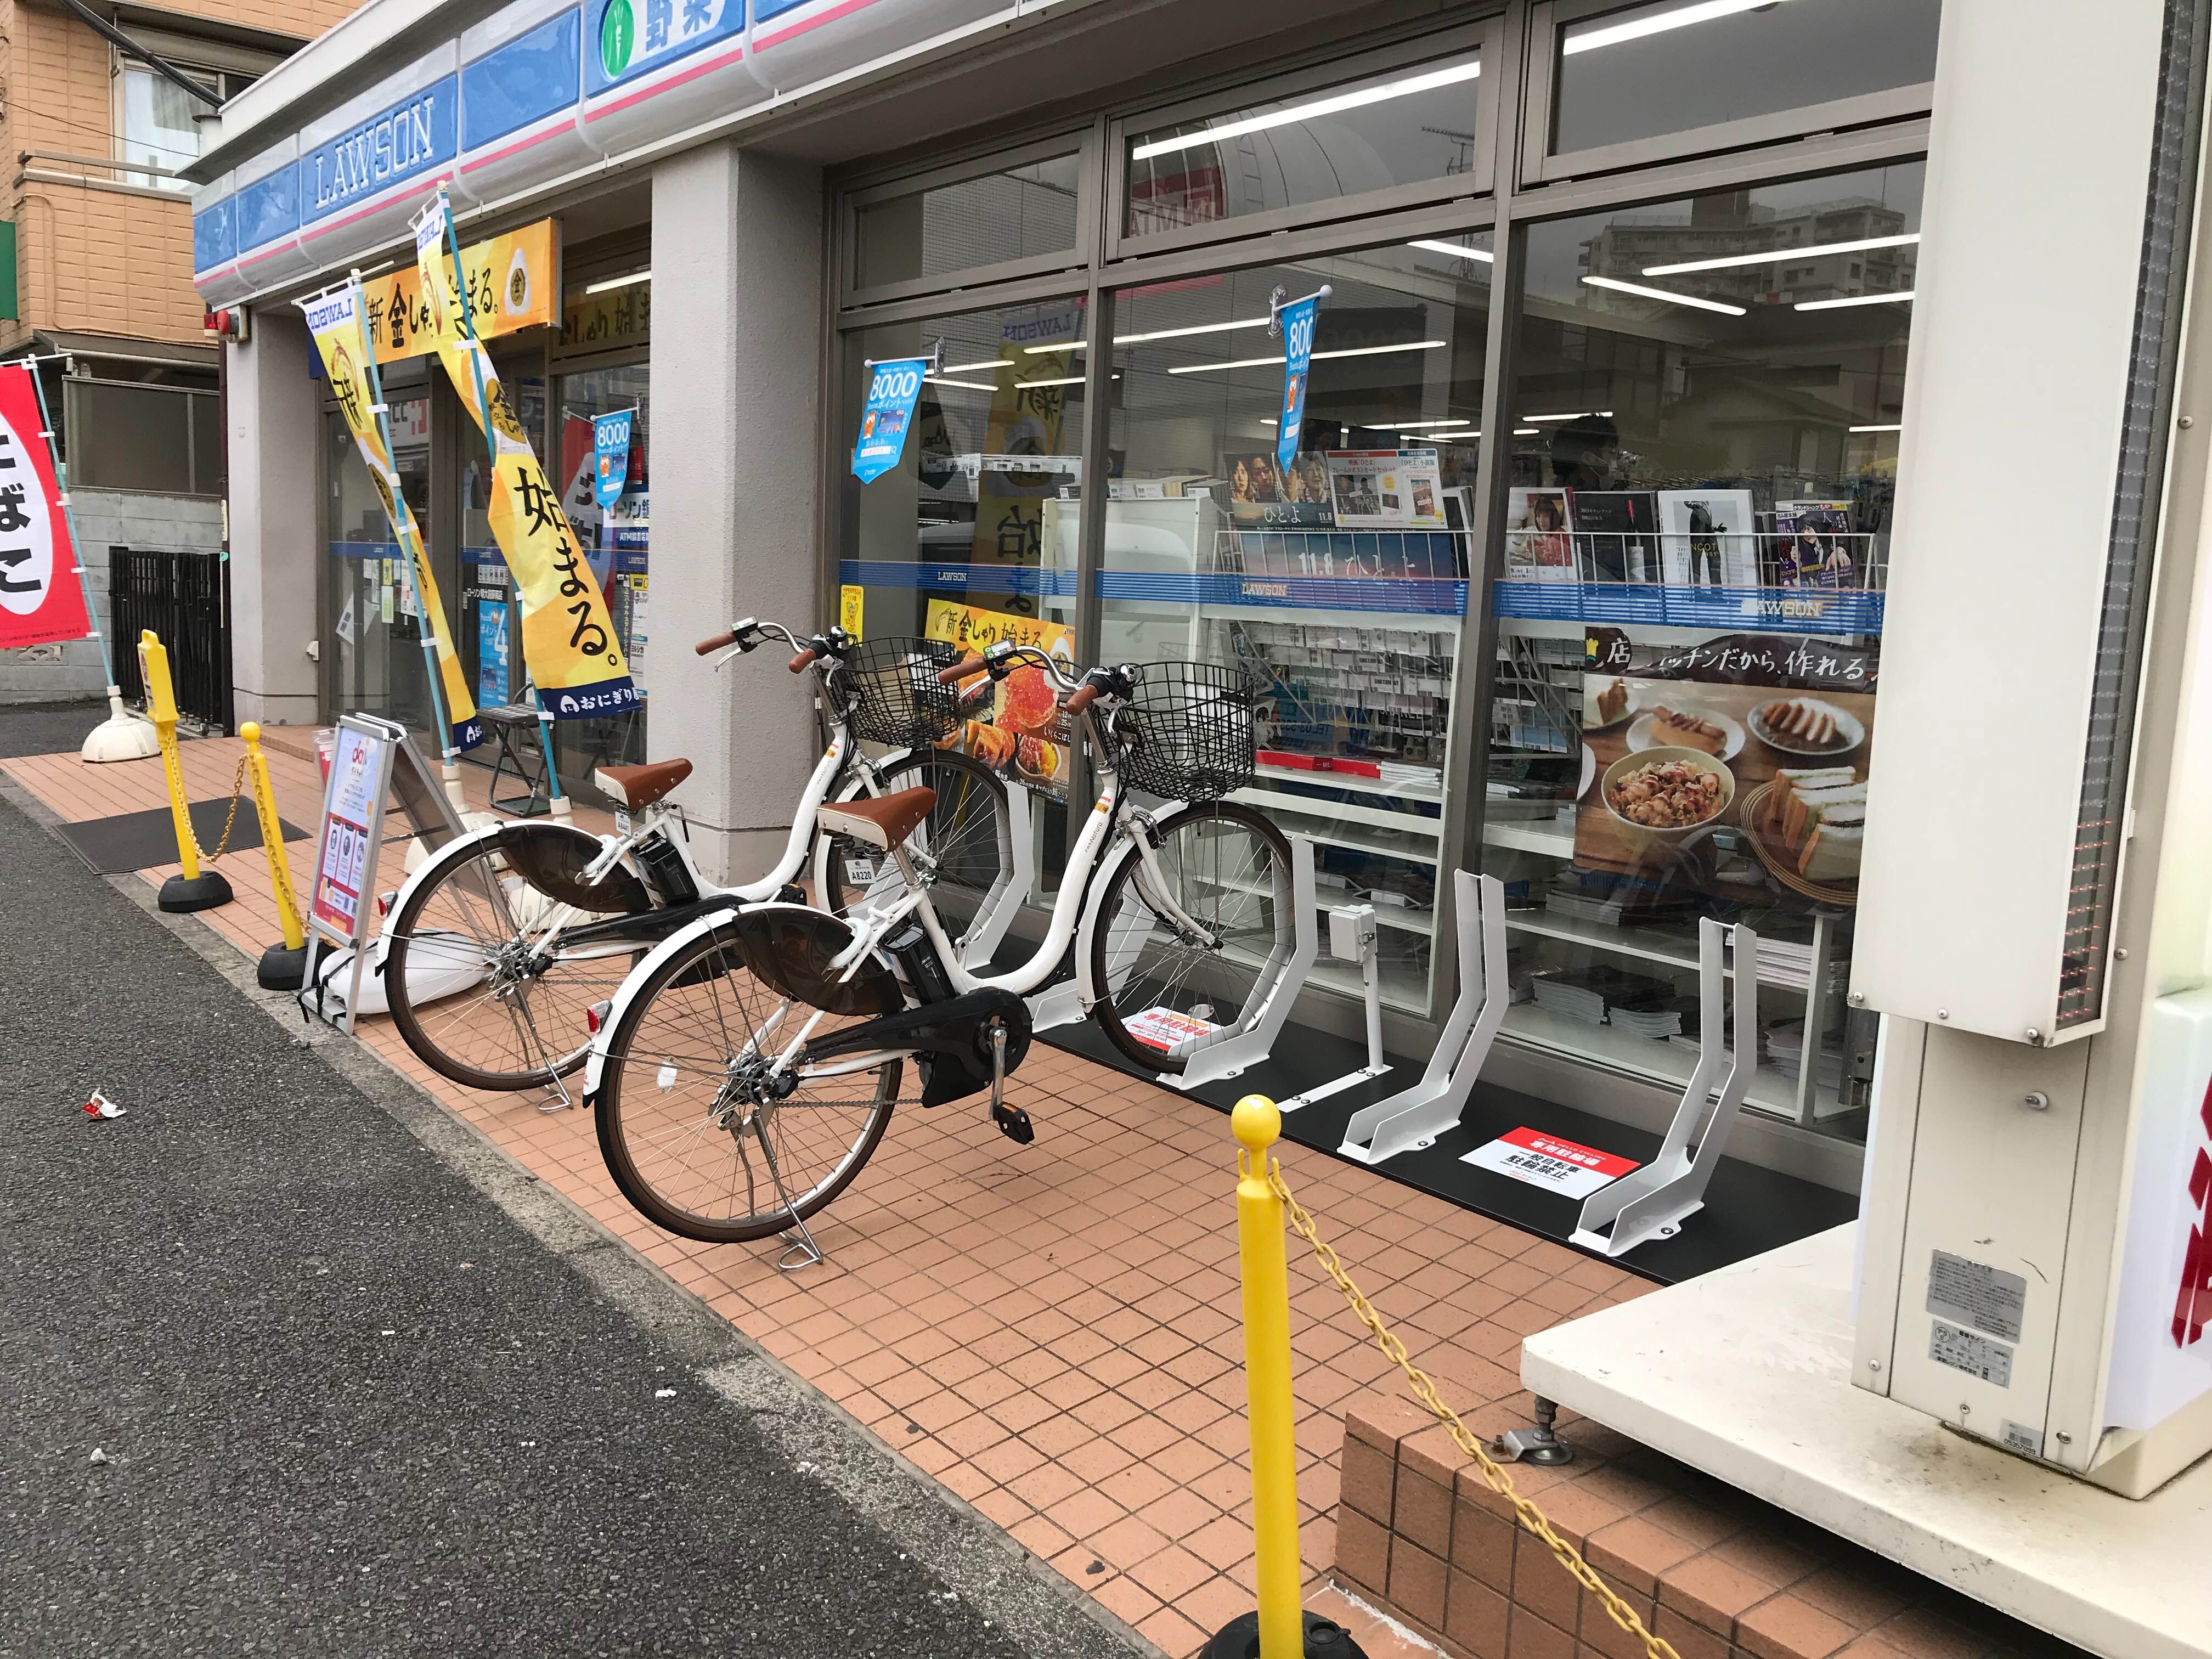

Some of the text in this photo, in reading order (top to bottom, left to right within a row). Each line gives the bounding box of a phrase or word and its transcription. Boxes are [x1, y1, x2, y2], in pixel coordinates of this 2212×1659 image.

[315, 96, 435, 210] LAWSON
[1289, 315, 1313, 359] 800
[869, 371, 918, 401] 8000
[597, 421, 629, 447] 8000
[1318, 511, 1333, 521] 11.8
[514, 465, 618, 667] 始まる。
[937, 571, 967, 582] LAWSON
[1242, 583, 1287, 597] LAWSON
[1756, 600, 1822, 617] AWSON
[1090, 822, 1103, 843] Natura
[852, 870, 872, 881] A8220
[1505, 1154, 1569, 1180] 駐輪禁止
[1519, 1151, 1582, 1173] 一般自転車
